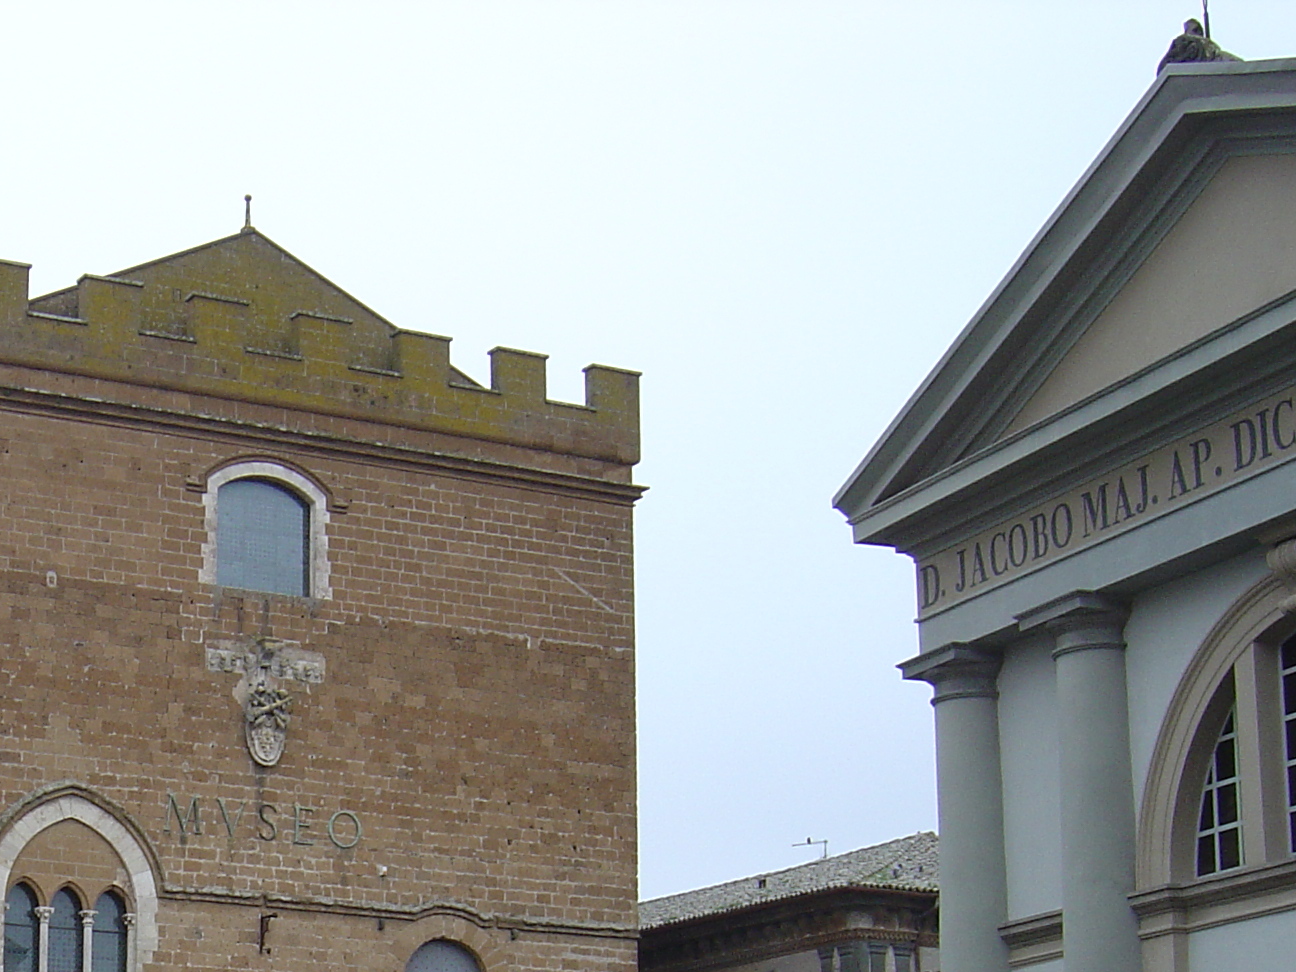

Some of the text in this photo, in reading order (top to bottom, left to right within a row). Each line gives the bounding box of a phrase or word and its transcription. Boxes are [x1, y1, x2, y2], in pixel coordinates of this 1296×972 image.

[920, 564, 946, 610] D.
[956, 503, 1073, 593] JACOBO
[1081, 464, 1159, 539] MAJ.
[1168, 438, 1222, 501] AP.
